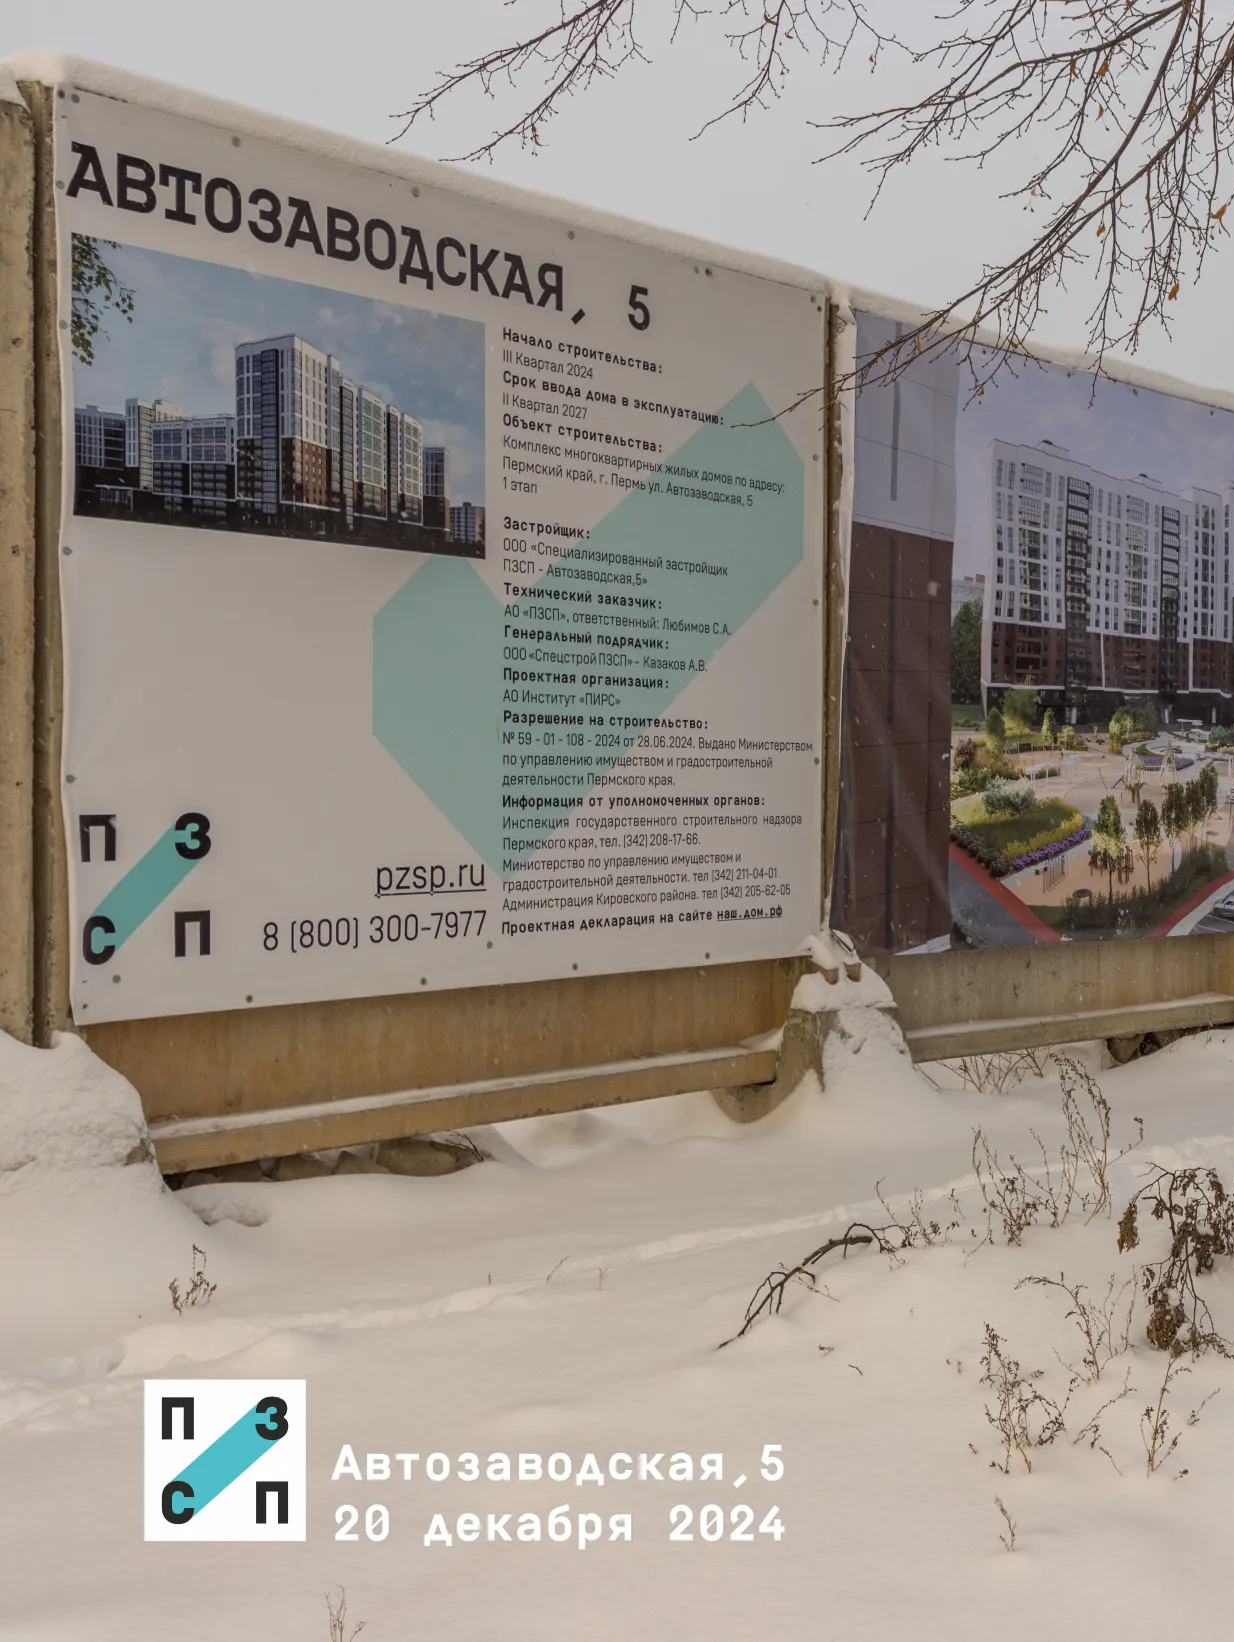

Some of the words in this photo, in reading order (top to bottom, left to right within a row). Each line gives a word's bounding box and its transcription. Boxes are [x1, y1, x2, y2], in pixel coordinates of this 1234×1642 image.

[65, 141, 587, 326] АВТОЗАВОДСКАЯ,
[627, 284, 651, 332] 5
[503, 328, 552, 350] Начало
[558, 341, 663, 373] строительства:
[503, 350, 512, 363] III
[516, 353, 564, 373] Квартал
[567, 363, 593, 379] 2024
[503, 371, 536, 388] Срок
[542, 380, 581, 397] ввода
[586, 390, 616, 404] дома
[622, 397, 629, 406] в
[634, 398, 724, 426] эксплуатацию:
[503, 394, 509, 405] II
[513, 396, 559, 414] Квартал
[562, 405, 587, 419] 2027
[503, 414, 552, 433] Объект
[558, 426, 663, 452] строительства:
[503, 436, 561, 457] Комплекс
[565, 450, 663, 473] многоквартирных
[665, 465, 699, 479] жилых
[702, 471, 733, 485] домов
[735, 476, 747, 487] по
[749, 478, 785, 493] адресу:
[503, 457, 563, 477] Пермский
[566, 467, 597, 484] край,
[600, 474, 608, 485] г.
[611, 474, 645, 491] Пермь
[649, 481, 663, 494] ул.
[667, 483, 745, 506] Автозаводская,
[747, 495, 753, 507] 5
[503, 478, 507, 489] 1
[511, 481, 538, 494] этап
[503, 517, 590, 539] Застройщик:
[503, 538, 526, 552] ООО
[531, 542, 663, 569] «Специализированный
[666, 559, 728, 576] застройщик
[503, 559, 535, 575] ПЗСП
[503, 583, 591, 603] Технический
[598, 593, 662, 610] заказчик:
[504, 605, 519, 618] АО
[523, 607, 569, 623] «ПЗСП»,
[573, 613, 659, 630] ответственный:
[663, 618, 710, 634] Любимов
[713, 622, 731, 635] С.А.
[504, 626, 591, 644] Генеральный
[597, 635, 669, 650] подрядчик:
[503, 647, 526, 660] ООО
[529, 649, 596, 667] «Спецстрой
[644, 657, 686, 670] Казаков
[689, 660, 708, 672] А.В.
[503, 669, 576, 684] Проектная
[582, 675, 669, 689] организация:
[503, 690, 519, 702] АО
[522, 691, 576, 707] Институт
[579, 693, 620, 706] «ПИРС»
[503, 711, 584, 726] Разрешение
[590, 717, 604, 726] на
[610, 717, 708, 729] строительство:
[503, 732, 515, 744] №
[518, 732, 532, 745] 59
[543, 733, 555, 745] 01
[567, 733, 584, 746] 108
[596, 735, 620, 746] 2024
[623, 738, 634, 746] от
[698, 738, 735, 751] Выдано
[739, 739, 813, 752] Министерством
[503, 755, 516, 766] по
[520, 755, 593, 769] управлению
[596, 756, 664, 769] имуществом
[667, 758, 673, 766] и
[676, 757, 772, 770] градостроительной
[502, 774, 584, 787] деятельности
[587, 774, 645, 787] Пермского
[649, 776, 675, 787] края.
[502, 795, 583, 809] Информация
[589, 797, 603, 807] от
[609, 796, 708, 809] уполномоченных
[714, 797, 765, 808] органов:
[503, 817, 569, 830] Инспекция
[576, 816, 677, 829] государственного
[683, 815, 757, 827] строительного
[763, 815, 802, 826] надзора
[79, 814, 116, 862] П
[503, 837, 565, 852] Пермского
[600, 836, 621, 847] тел.
[650, 834, 700, 846] 208-17-66.
[503, 859, 585, 871] Министерство
[588, 857, 600, 869] по
[604, 855, 668, 870] управлению
[671, 853, 733, 867] имуществом
[735, 854, 741, 862] и
[375, 863, 486, 896] pzsp.ru
[503, 877, 613, 892] градостроительной
[693, 871, 708, 882] тел
[736, 867, 777, 880] 211-04-01
[502, 896, 593, 912] Администрация
[597, 892, 657, 906] Кировского
[702, 887, 718, 899] тел
[746, 884, 791, 897] 205-62-05
[264, 922, 278, 951] 8
[291, 916, 359, 953] (800)
[369, 910, 487, 943] 300-7977
[501, 919, 574, 936] Проектная
[580, 915, 655, 931] декларация
[660, 913, 673, 923] на
[679, 910, 712, 923] сайте
[717, 905, 782, 920] наш.дом.рф
[83, 916, 116, 965] С
[175, 910, 210, 957] П
